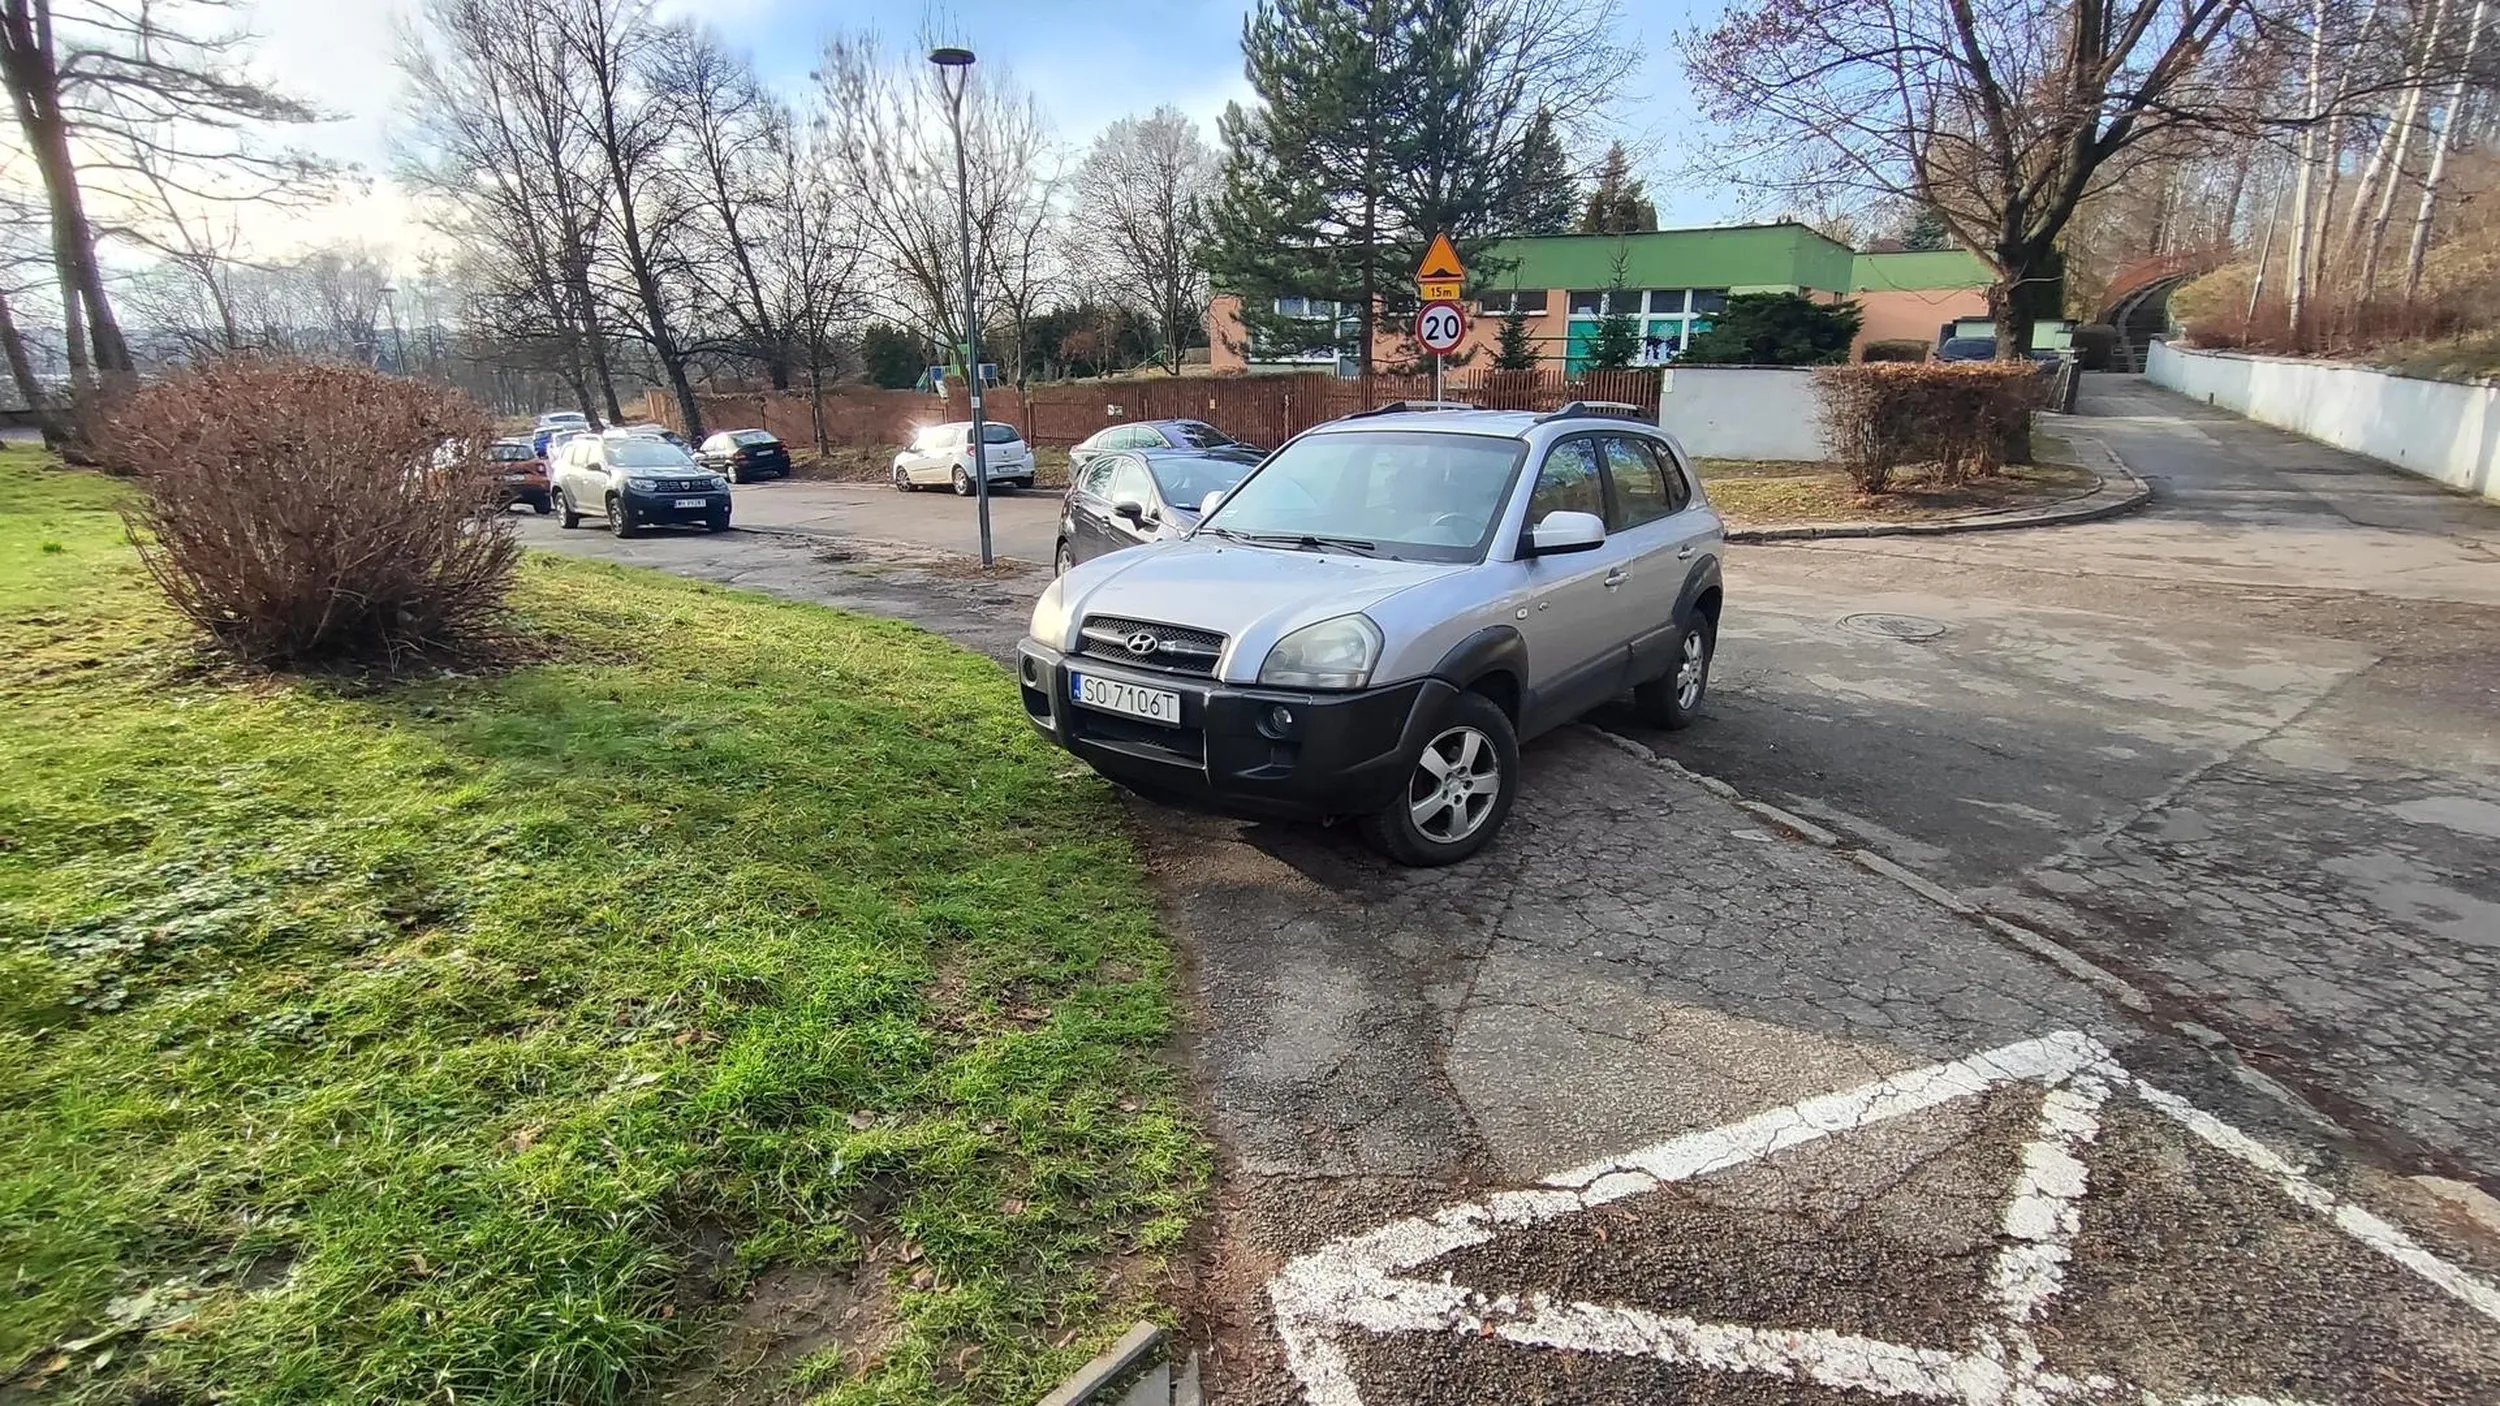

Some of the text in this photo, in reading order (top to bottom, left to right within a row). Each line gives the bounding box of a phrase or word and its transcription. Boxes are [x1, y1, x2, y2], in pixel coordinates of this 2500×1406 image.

[1425, 315, 1460, 341] 20
[1084, 678, 1174, 720] SO 7106T
